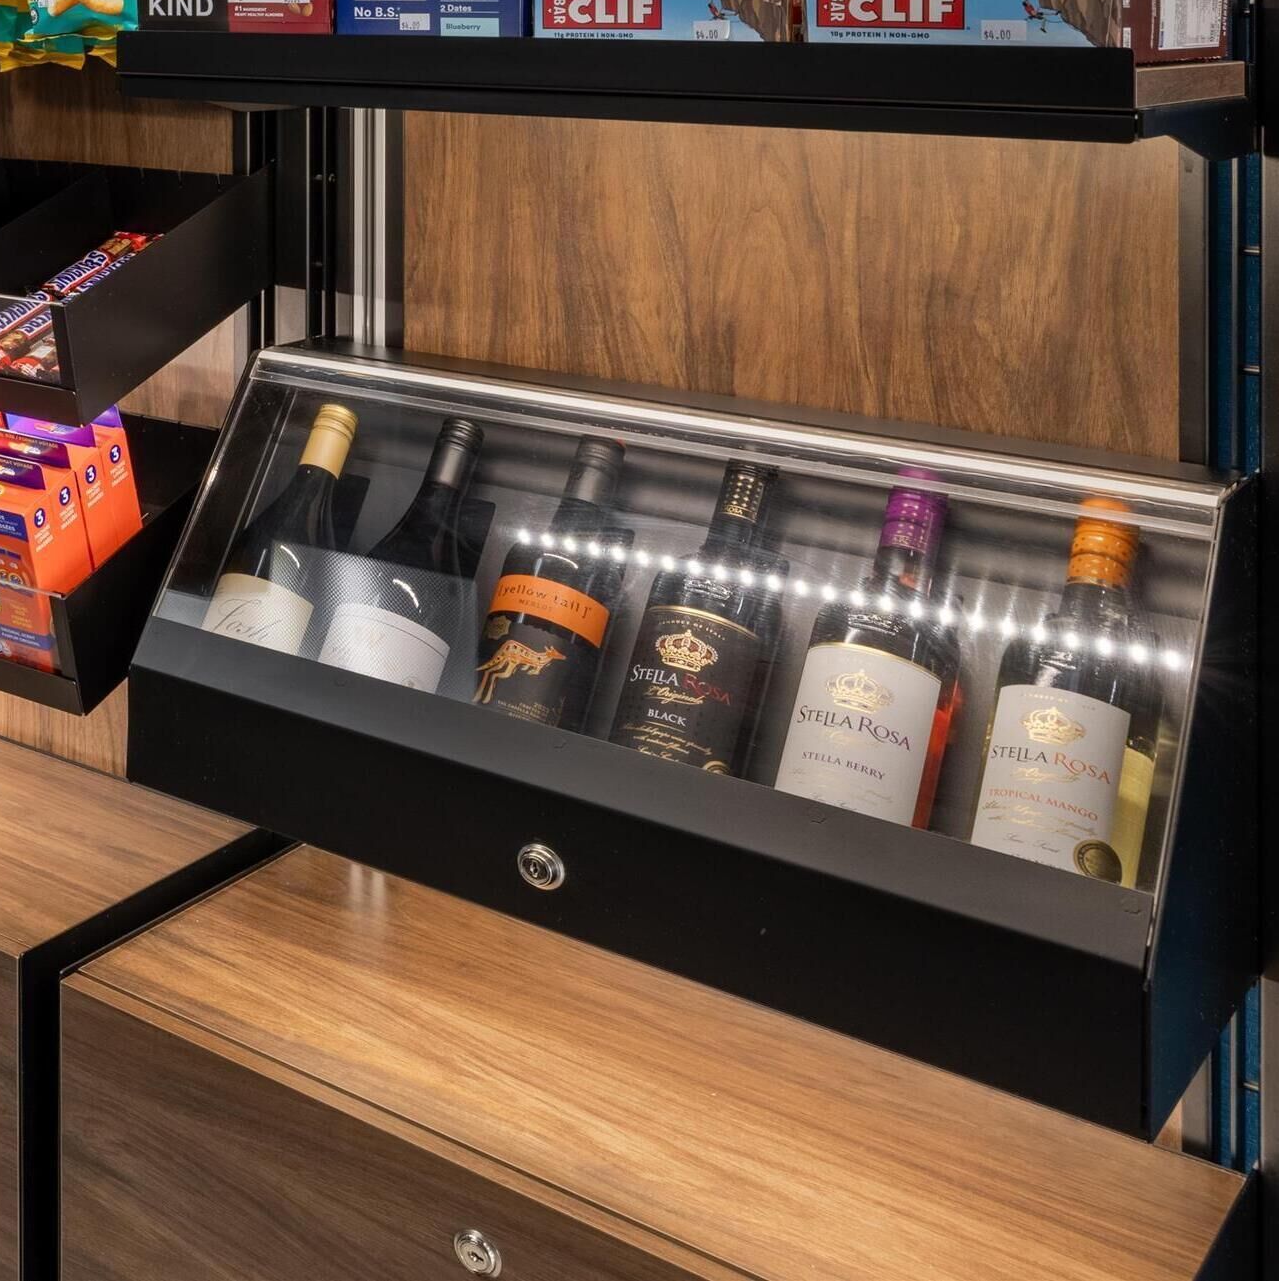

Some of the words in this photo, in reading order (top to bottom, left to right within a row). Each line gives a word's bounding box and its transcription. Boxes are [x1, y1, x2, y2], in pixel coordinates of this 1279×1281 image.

[354, 7, 372, 18] No
[375, 7, 399, 18] B.S.
[445, 22, 481, 31] Blueberry
[696, 30, 719, 40] $4.00
[889, 31, 930, 39] NON-GMO
[983, 30, 1011, 40] $4.00
[630, 664, 679, 687] STELLA
[683, 672, 732, 706] ROSA
[647, 708, 687, 727] BLACK
[796, 704, 854, 730] STELLA
[857, 715, 913, 751] ROSA
[801, 750, 843, 767] STELLA
[845, 759, 887, 782] BERRY
[991, 745, 1048, 764] STELLA
[1053, 751, 1110, 785] ROSA
[988, 788, 1042, 803] TROPICAL
[1046, 797, 1098, 821] MANGO
